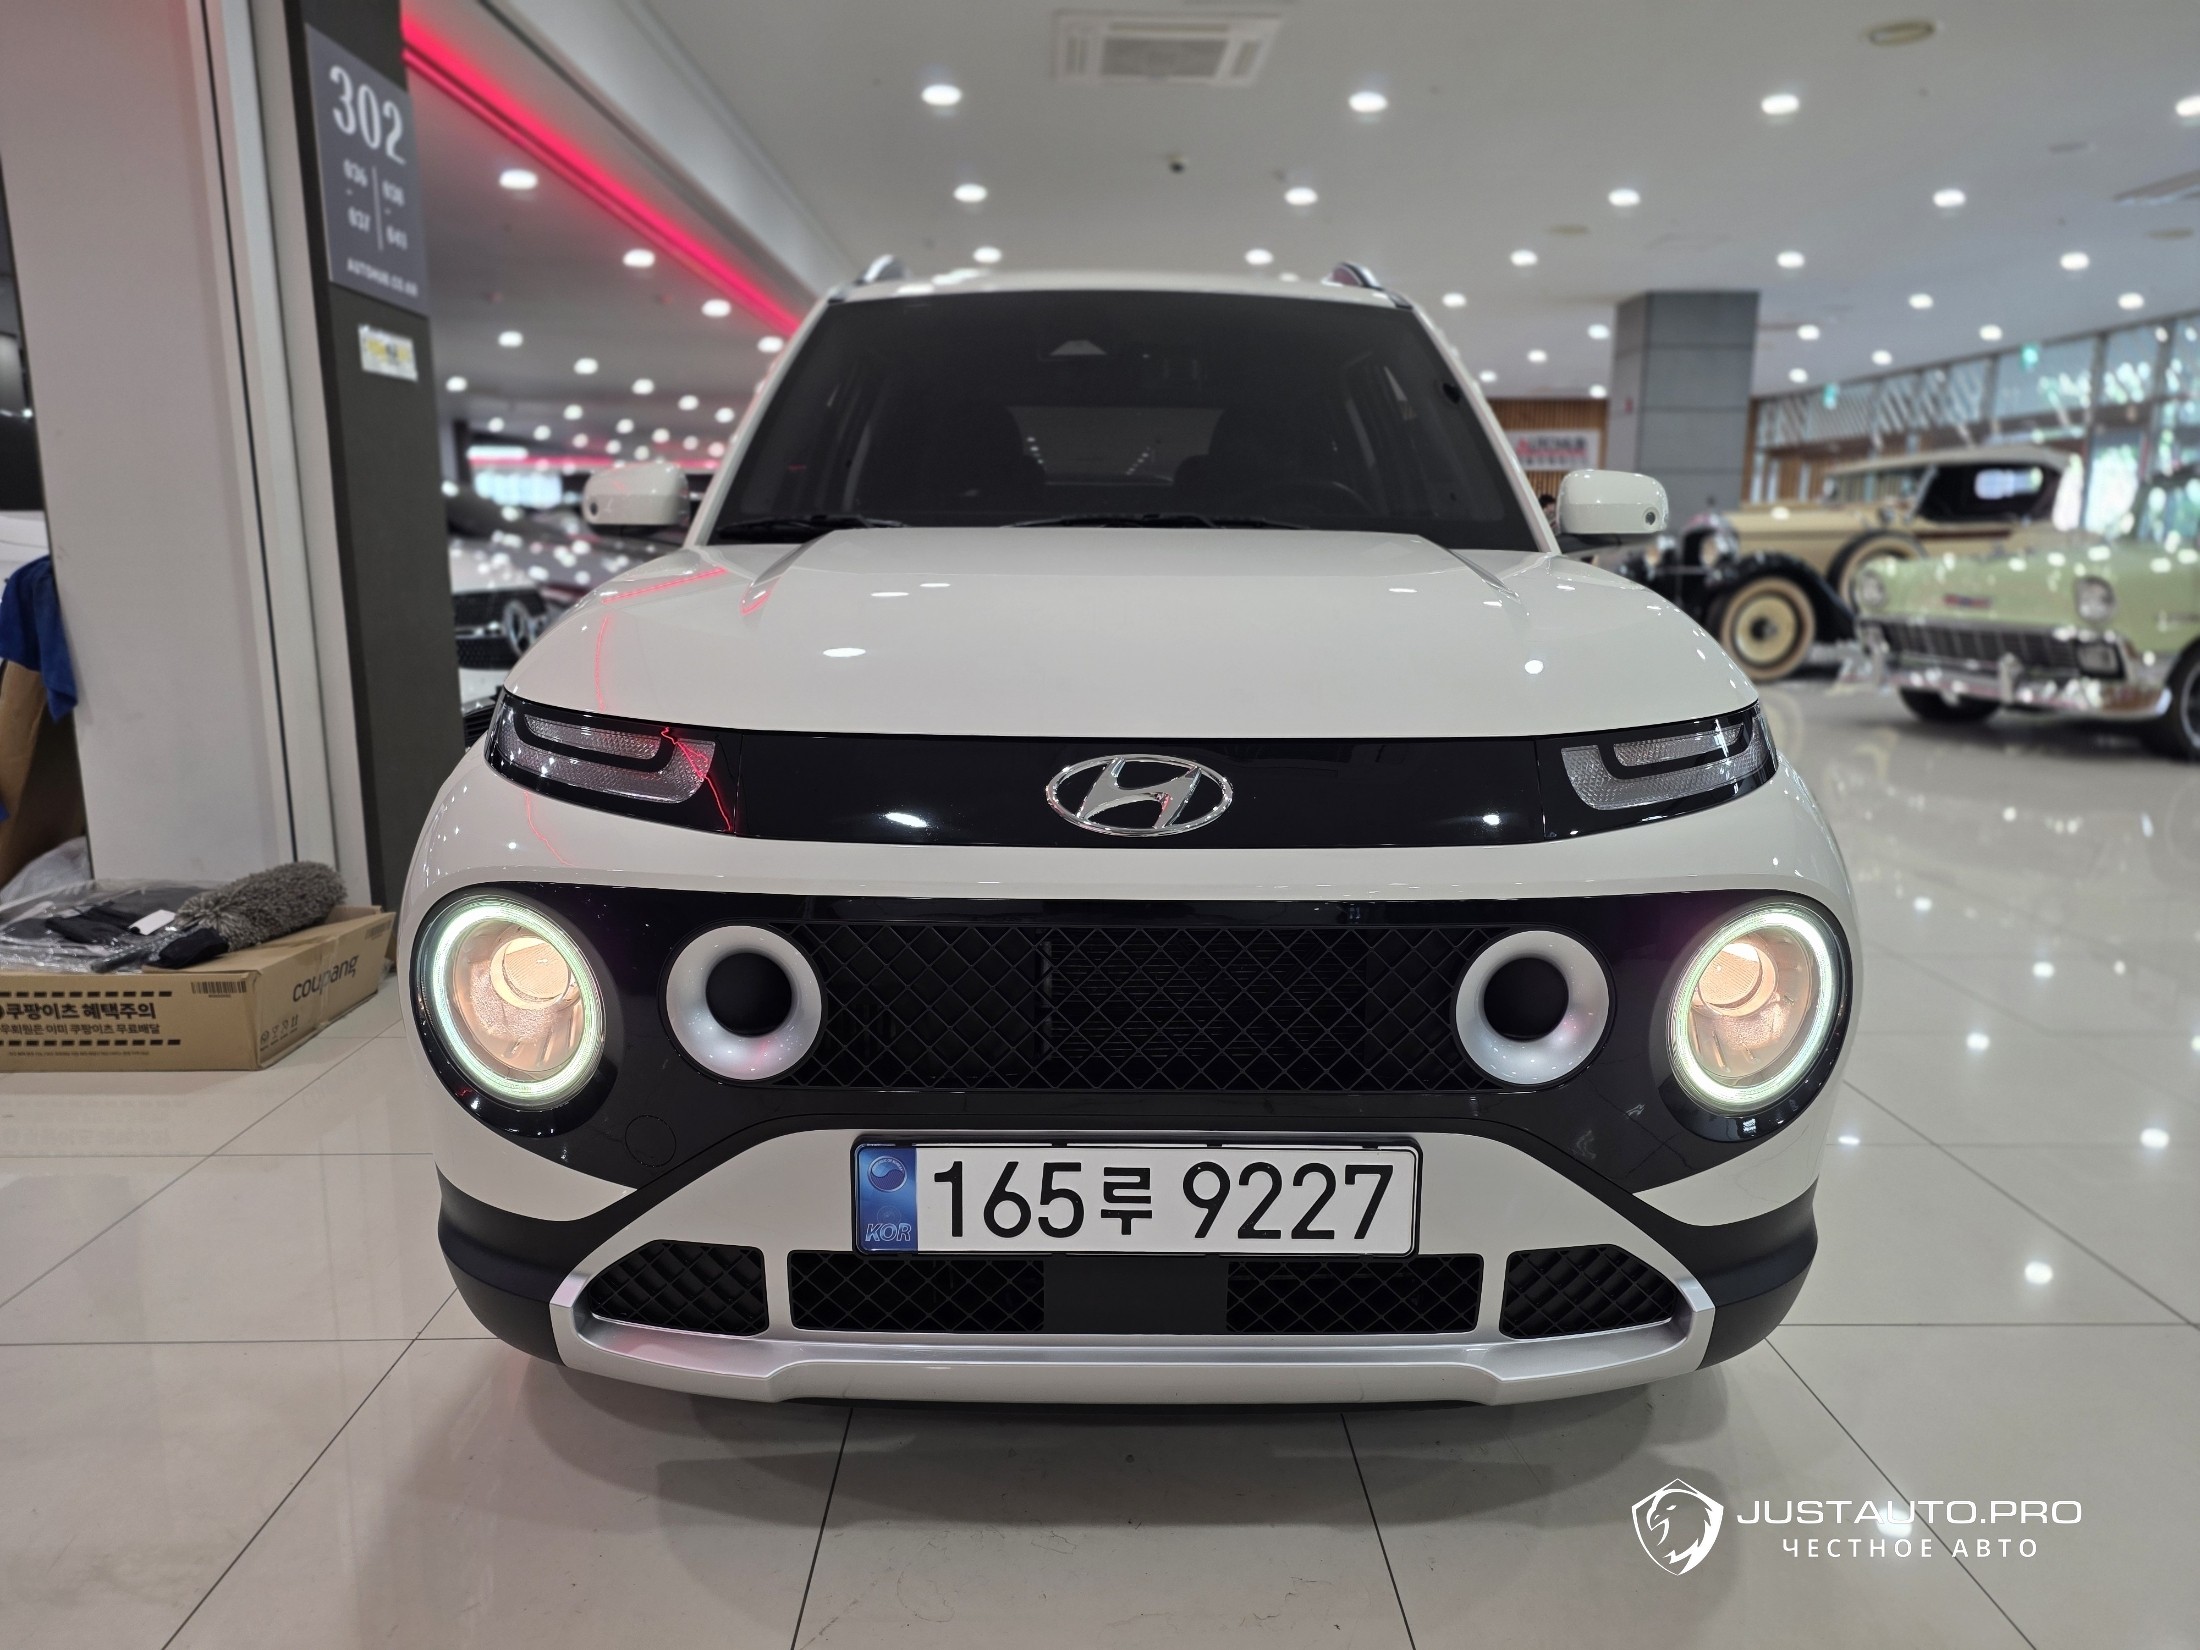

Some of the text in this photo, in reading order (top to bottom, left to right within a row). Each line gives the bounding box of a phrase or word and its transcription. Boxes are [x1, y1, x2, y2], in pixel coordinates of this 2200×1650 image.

[329, 65, 406, 165] 302
[292, 954, 360, 1003] coupang
[6, 1002, 157, 1020] 쿠팡이츠 혜택주의
[0, 1023, 45, 1036] 우회원은
[70, 1024, 115, 1035] 쿠팡이츠
[116, 1023, 161, 1035] 무료배달
[1182, 1161, 1394, 1240] 9227
[865, 1223, 912, 1242] KOR
